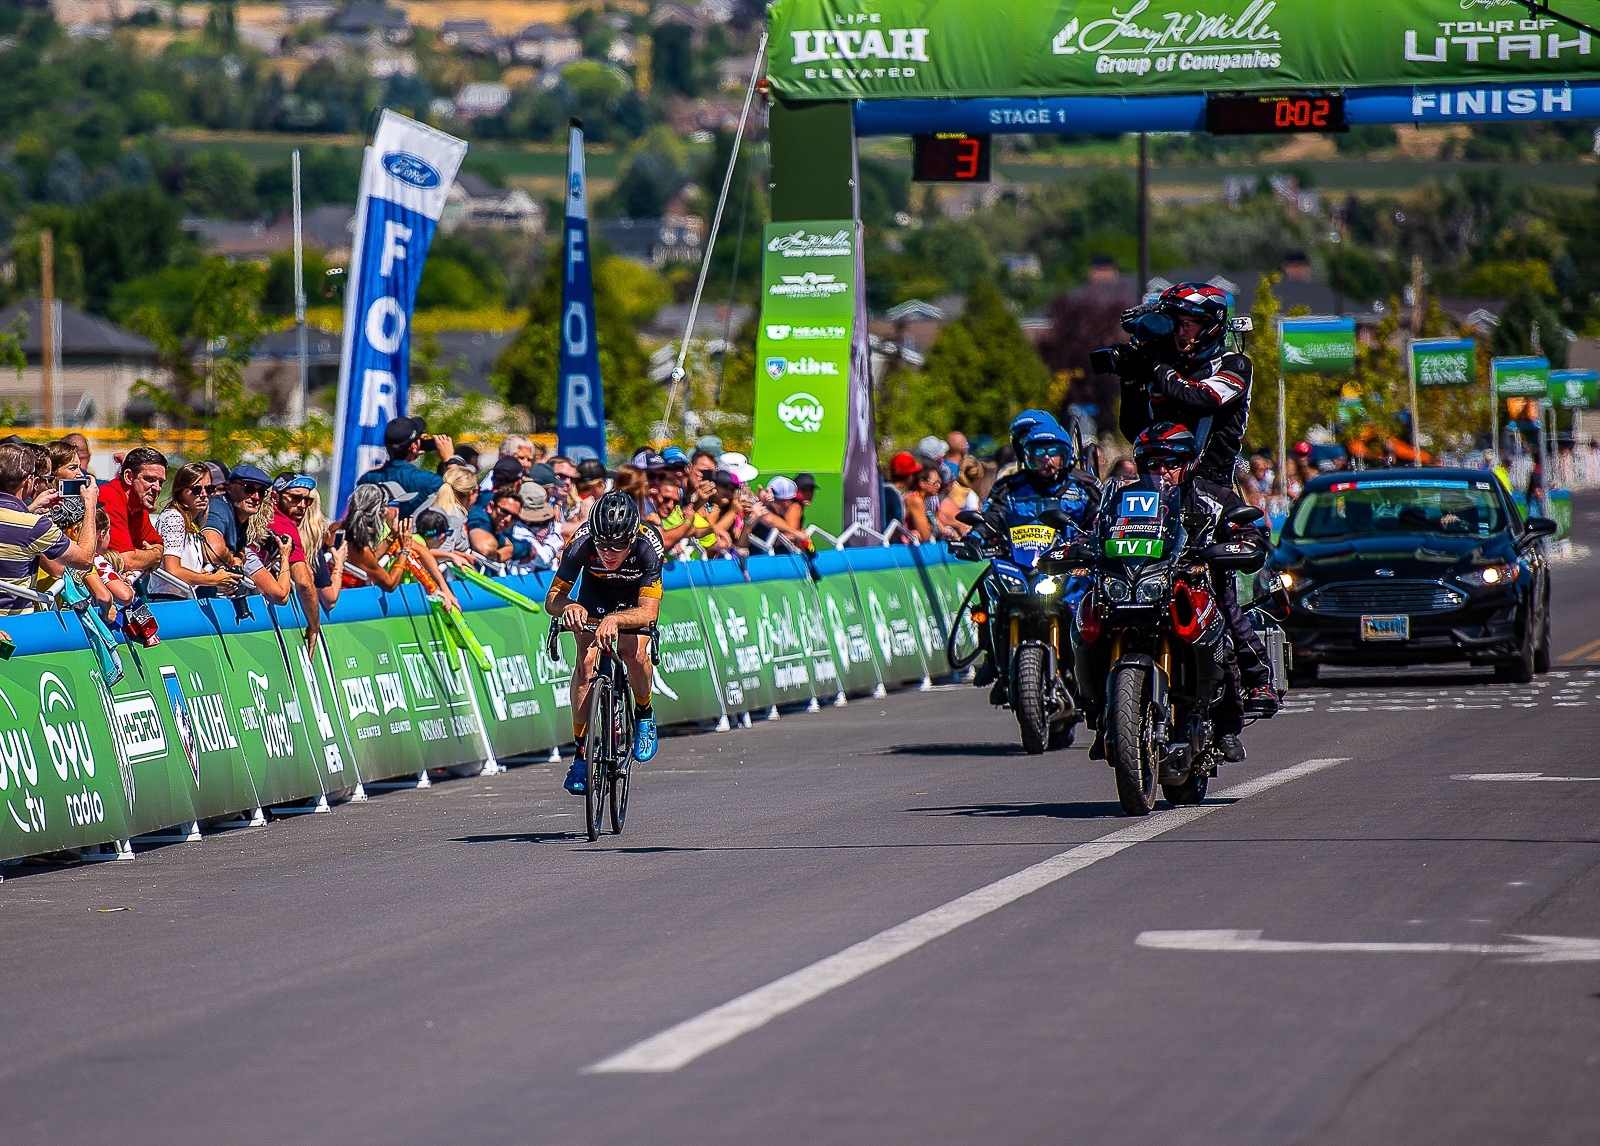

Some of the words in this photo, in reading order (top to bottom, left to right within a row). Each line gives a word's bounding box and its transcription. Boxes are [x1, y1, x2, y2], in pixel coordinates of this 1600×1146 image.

[835, 13, 882, 24] LIFE
[1078, 0, 1165, 54] Larry
[1185, 0, 1281, 45] Miller
[1437, 20, 1515, 36] TOUR
[1519, 19, 1559, 31] OF
[790, 27, 930, 65] UTAH
[1404, 25, 1592, 62] UTAH
[805, 68, 916, 79] ELEVATED
[1096, 54, 1151, 76] Group
[1156, 52, 1177, 72] of
[1179, 50, 1281, 73] Companies
[1275, 100, 1330, 127] 0:02
[1412, 87, 1573, 116] FINISH
[989, 109, 1051, 125] STAGE
[1057, 110, 1067, 124] 1
[955, 138, 980, 178] 3
[1126, 496, 1155, 512] TV
[1012, 527, 1052, 535] NEUTRAL
[1115, 540, 1140, 554] TV
[1145, 540, 1153, 554] 1
[496, 653, 535, 695] HEALTH
[187, 671, 239, 753] KÜHL
[39, 711, 96, 782] byu
[25, 787, 47, 833] tv
[65, 784, 105, 827] radio
